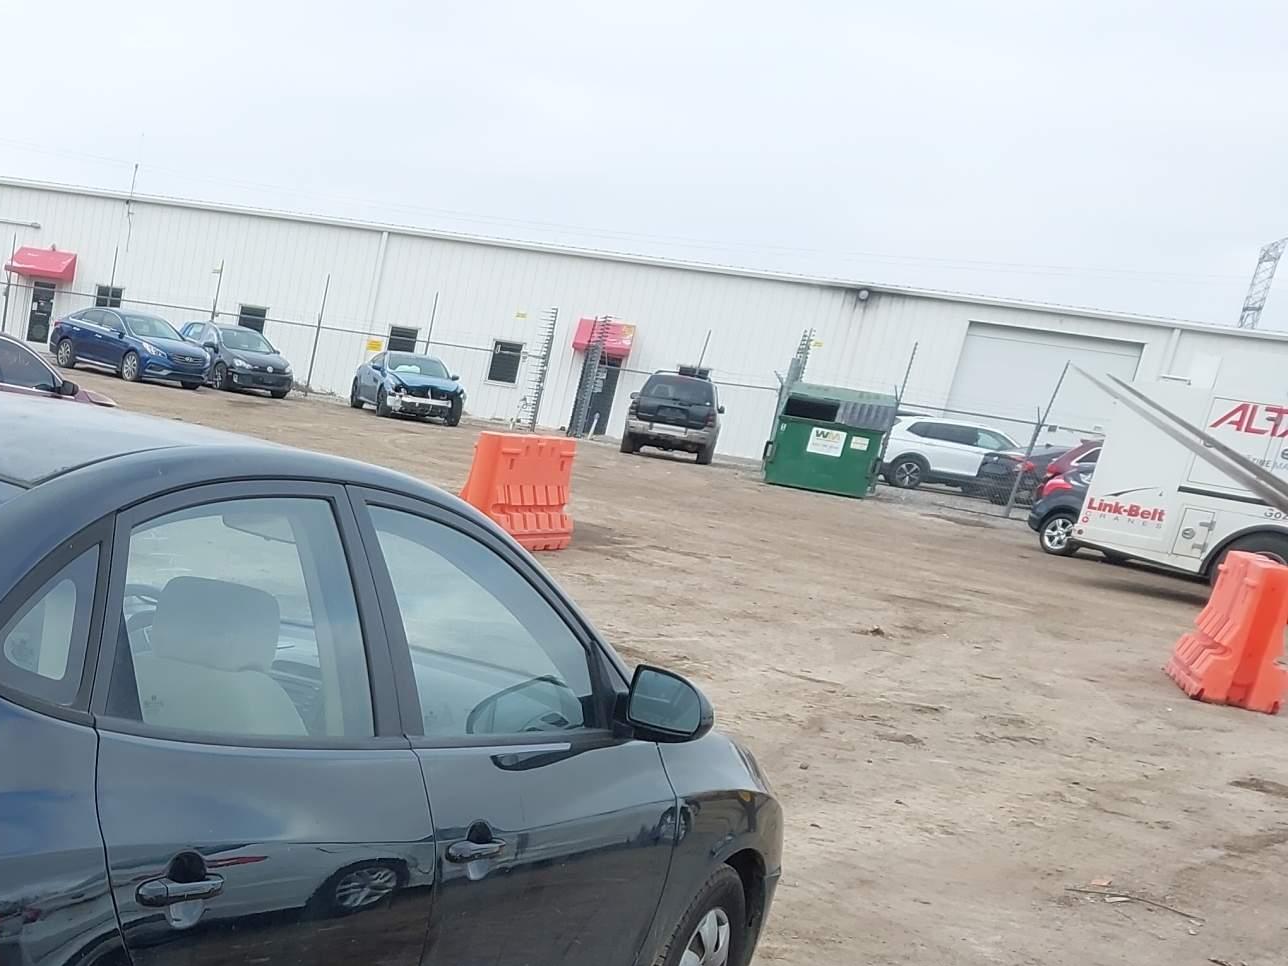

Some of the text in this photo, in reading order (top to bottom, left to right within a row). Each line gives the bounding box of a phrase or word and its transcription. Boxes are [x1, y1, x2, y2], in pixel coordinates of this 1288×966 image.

[1210, 402, 1288, 438] ALT
[1085, 510, 1162, 529] CRANES
[1087, 498, 1166, 522] Link-Belt
